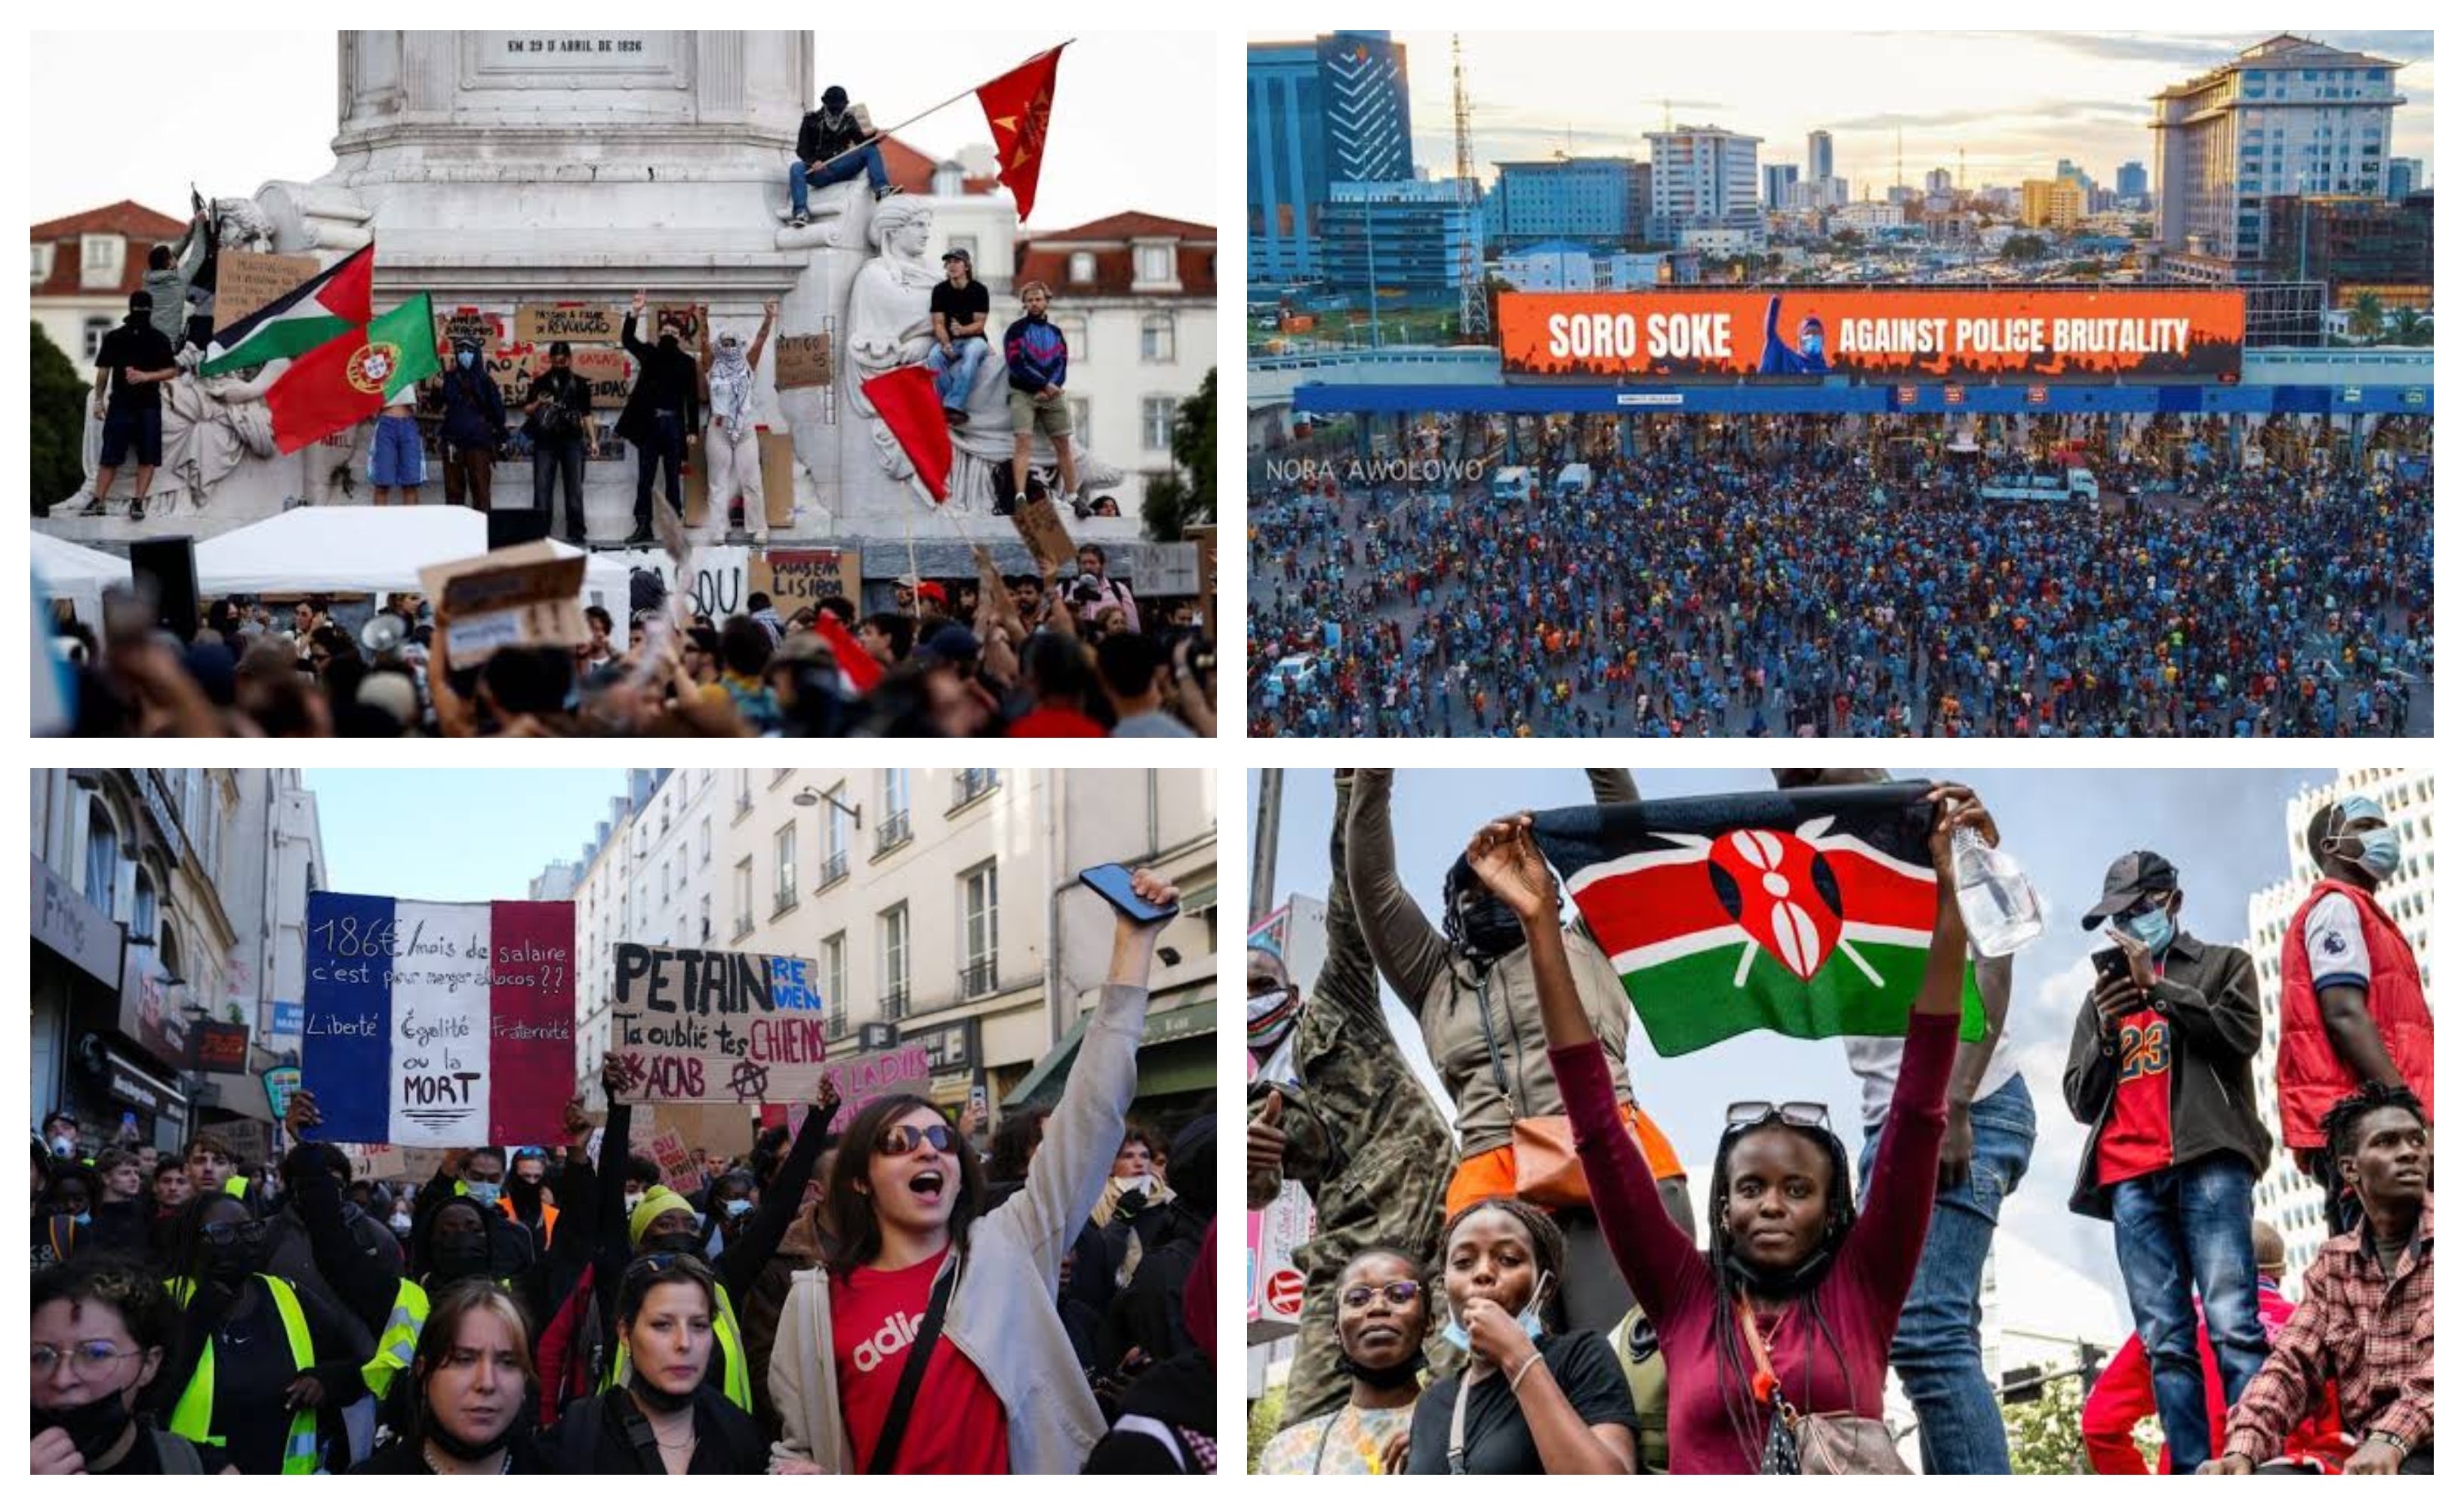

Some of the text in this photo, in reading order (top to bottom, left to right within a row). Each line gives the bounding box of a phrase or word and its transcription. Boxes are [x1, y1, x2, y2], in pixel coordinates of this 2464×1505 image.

[508, 40, 523, 52] EM
[560, 40, 592, 52] ABRIL
[599, 40, 612, 52] DE
[1549, 313, 1733, 359] SORO SOKE
[1840, 317, 2190, 353] AGAINST POLICE BRUTALITY
[466, 933, 488, 960] de
[312, 960, 370, 984] c'est
[615, 944, 806, 1015] PETAIN RE
[306, 1013, 377, 1037] Liberté
[493, 1016, 569, 1040] Fraternité
[648, 1016, 708, 1050] oublié
[713, 1020, 749, 1056] tes
[750, 1019, 827, 1064] CHIENS
[402, 1047, 461, 1069] ou la
[2118, 1021, 2170, 1080] 23
[404, 1072, 481, 1105] MORT
